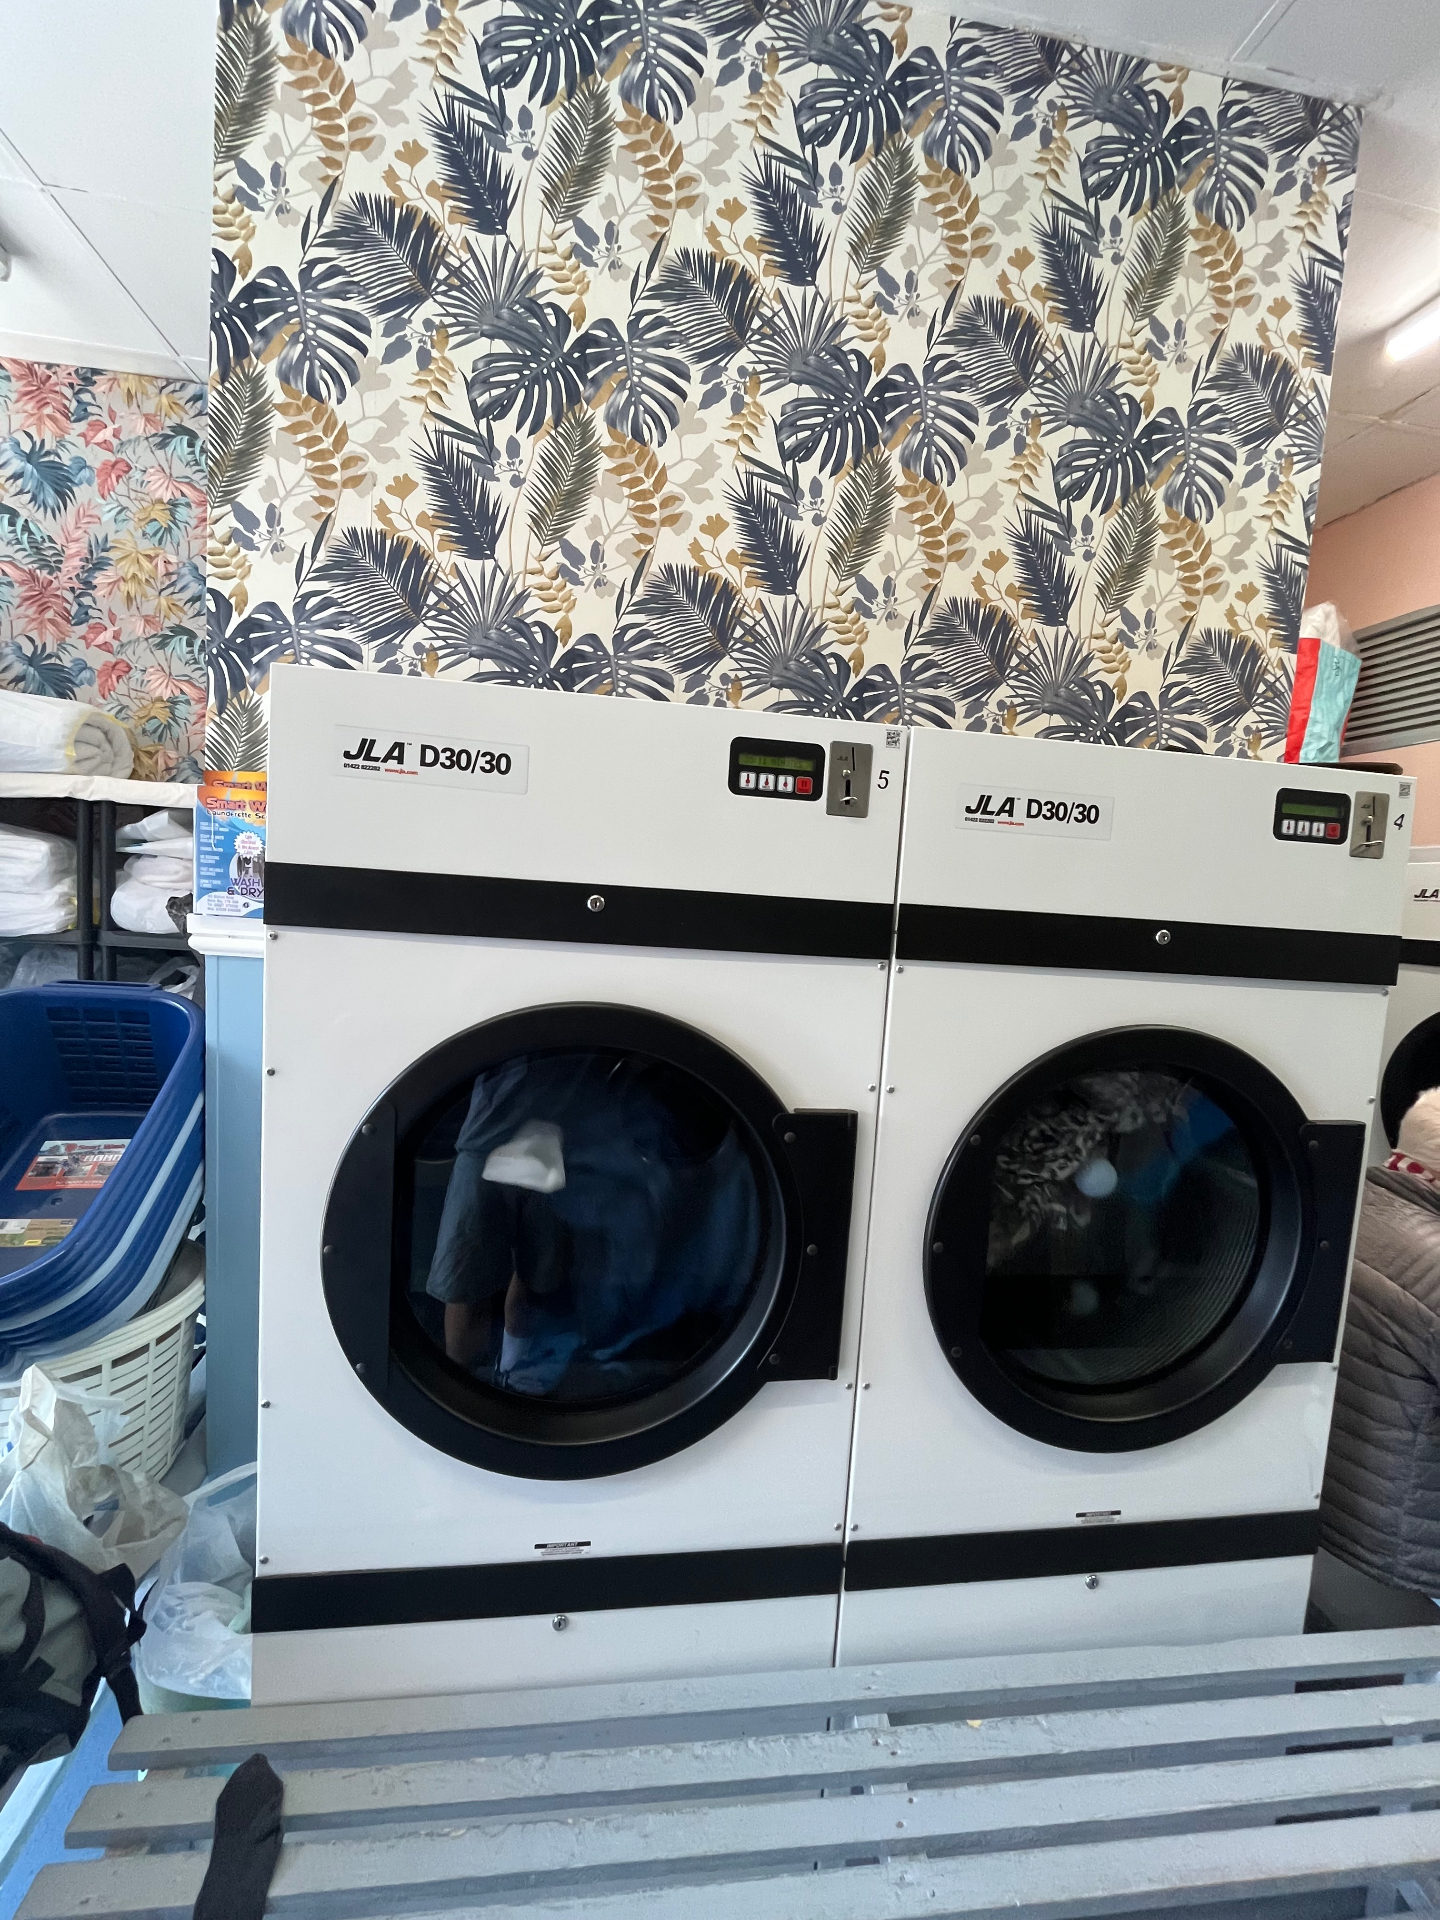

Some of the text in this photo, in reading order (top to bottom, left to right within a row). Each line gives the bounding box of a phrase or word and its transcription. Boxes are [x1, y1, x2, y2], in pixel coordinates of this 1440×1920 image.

[419, 744, 512, 775] D30/30
[877, 770, 890, 790] 5
[206, 797, 246, 811] Smart
[1026, 798, 1100, 825] D30/30
[1394, 813, 1406, 831] 4
[230, 878, 260, 887] WASH
[240, 887, 265, 898] DRY
